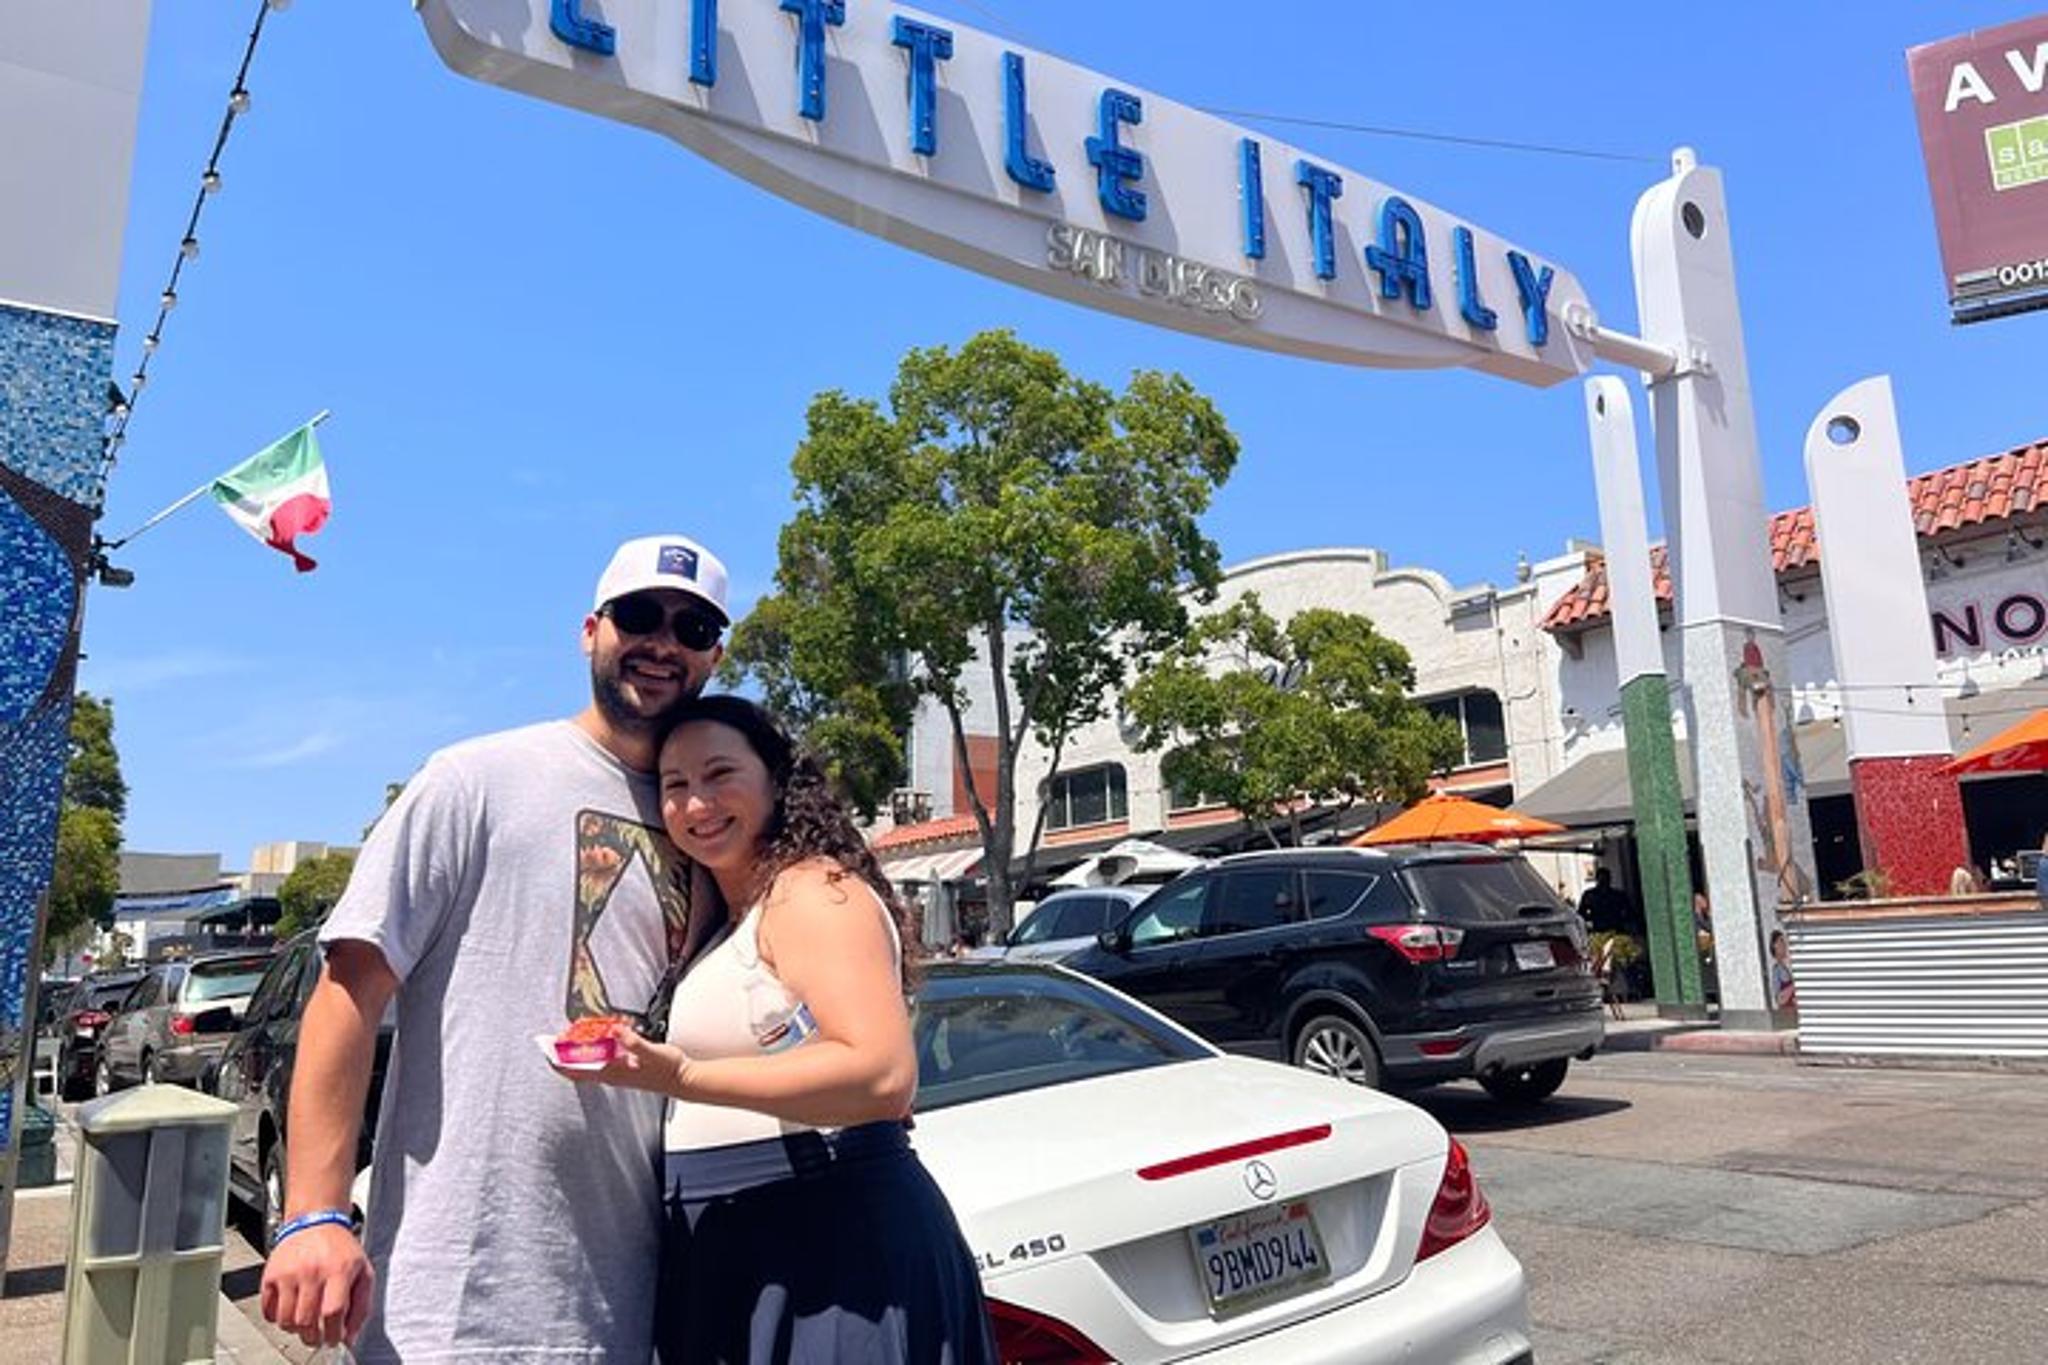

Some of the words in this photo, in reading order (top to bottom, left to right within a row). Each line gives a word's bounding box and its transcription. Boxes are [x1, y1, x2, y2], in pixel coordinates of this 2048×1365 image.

[1944, 61, 1996, 112] A
[1048, 223, 1125, 286] SAN
[1139, 252, 1264, 322] DIEGO
[1238, 137, 1555, 347] ITALY
[1009, 1233, 1066, 1261] 450
[1208, 1228, 1318, 1296] 9BMD944
